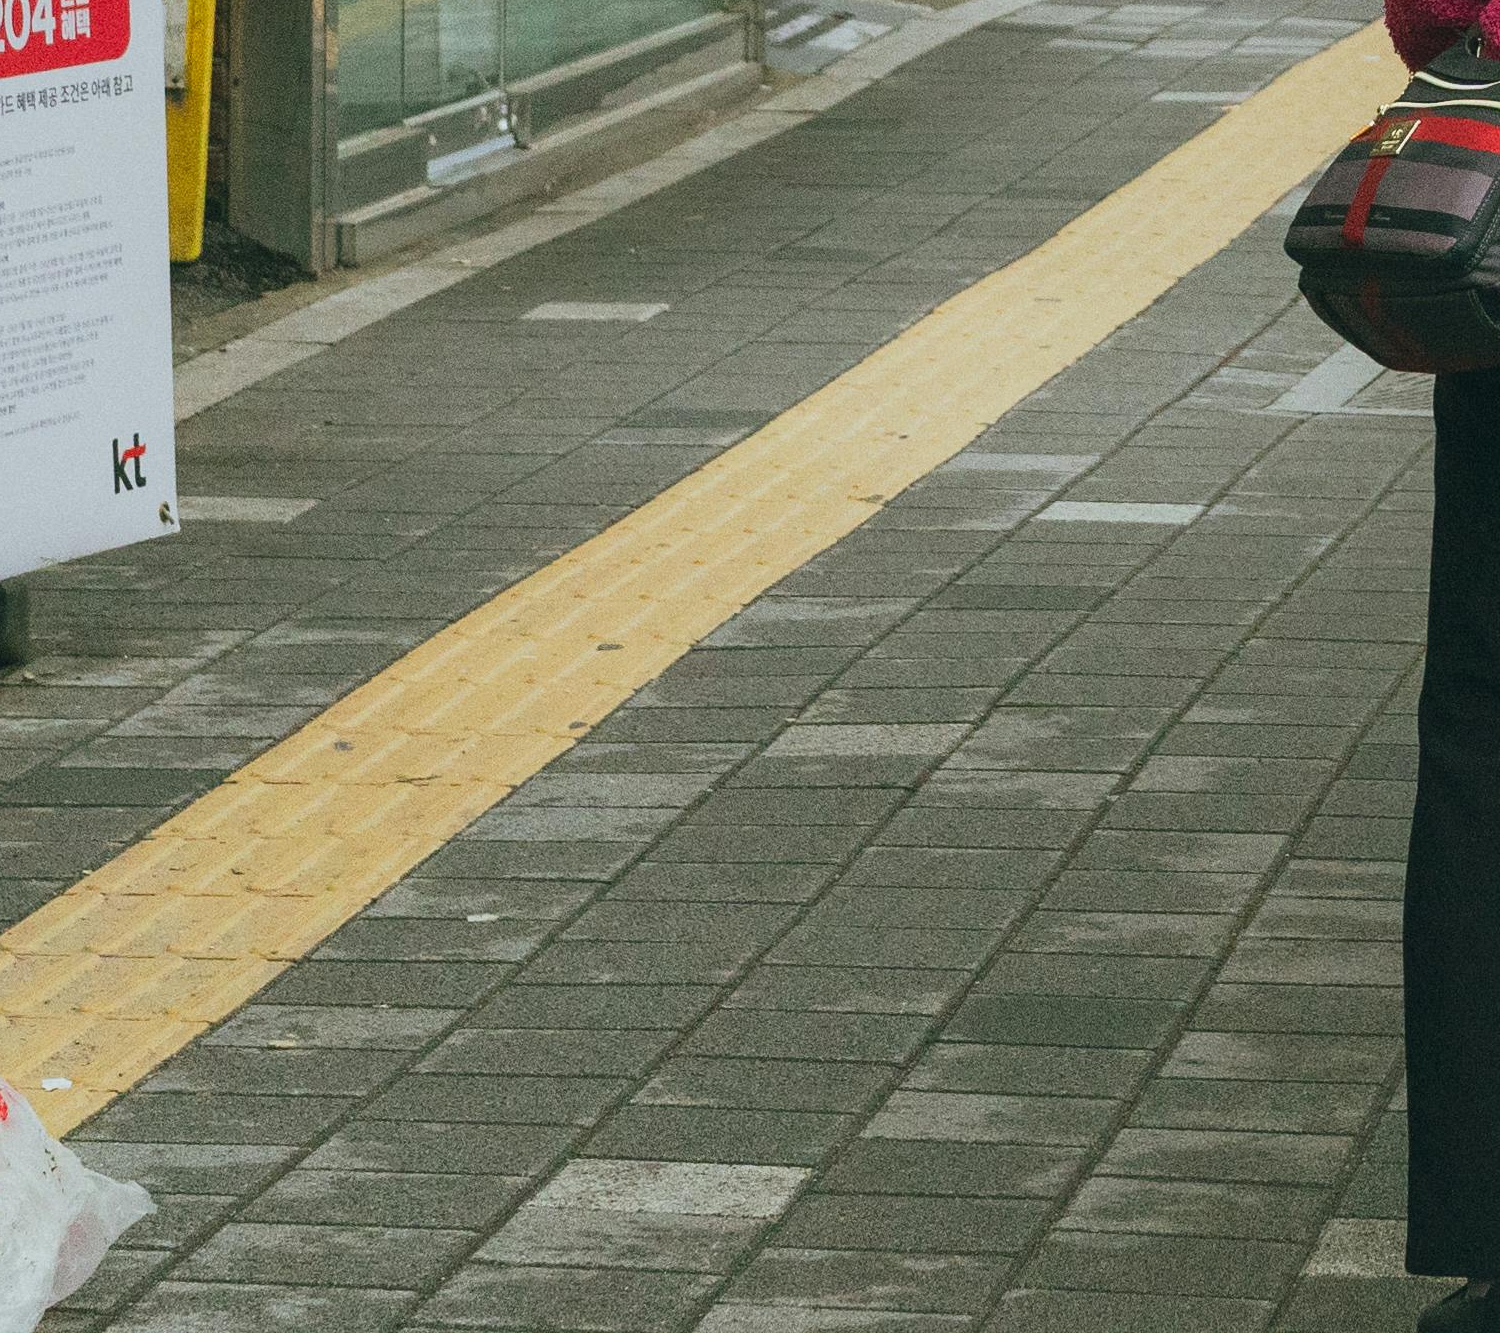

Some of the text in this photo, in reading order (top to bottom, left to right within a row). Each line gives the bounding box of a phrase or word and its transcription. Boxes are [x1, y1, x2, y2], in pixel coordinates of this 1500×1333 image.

[61, 7, 91, 41] 혜택
[17, 90, 37, 112] 혜택
[38, 86, 59, 109] 제공
[60, 80, 90, 105] 조건은
[91, 76, 112, 98] 아래
[113, 74, 135, 97] 참고
[112, 432, 147, 494] kt
